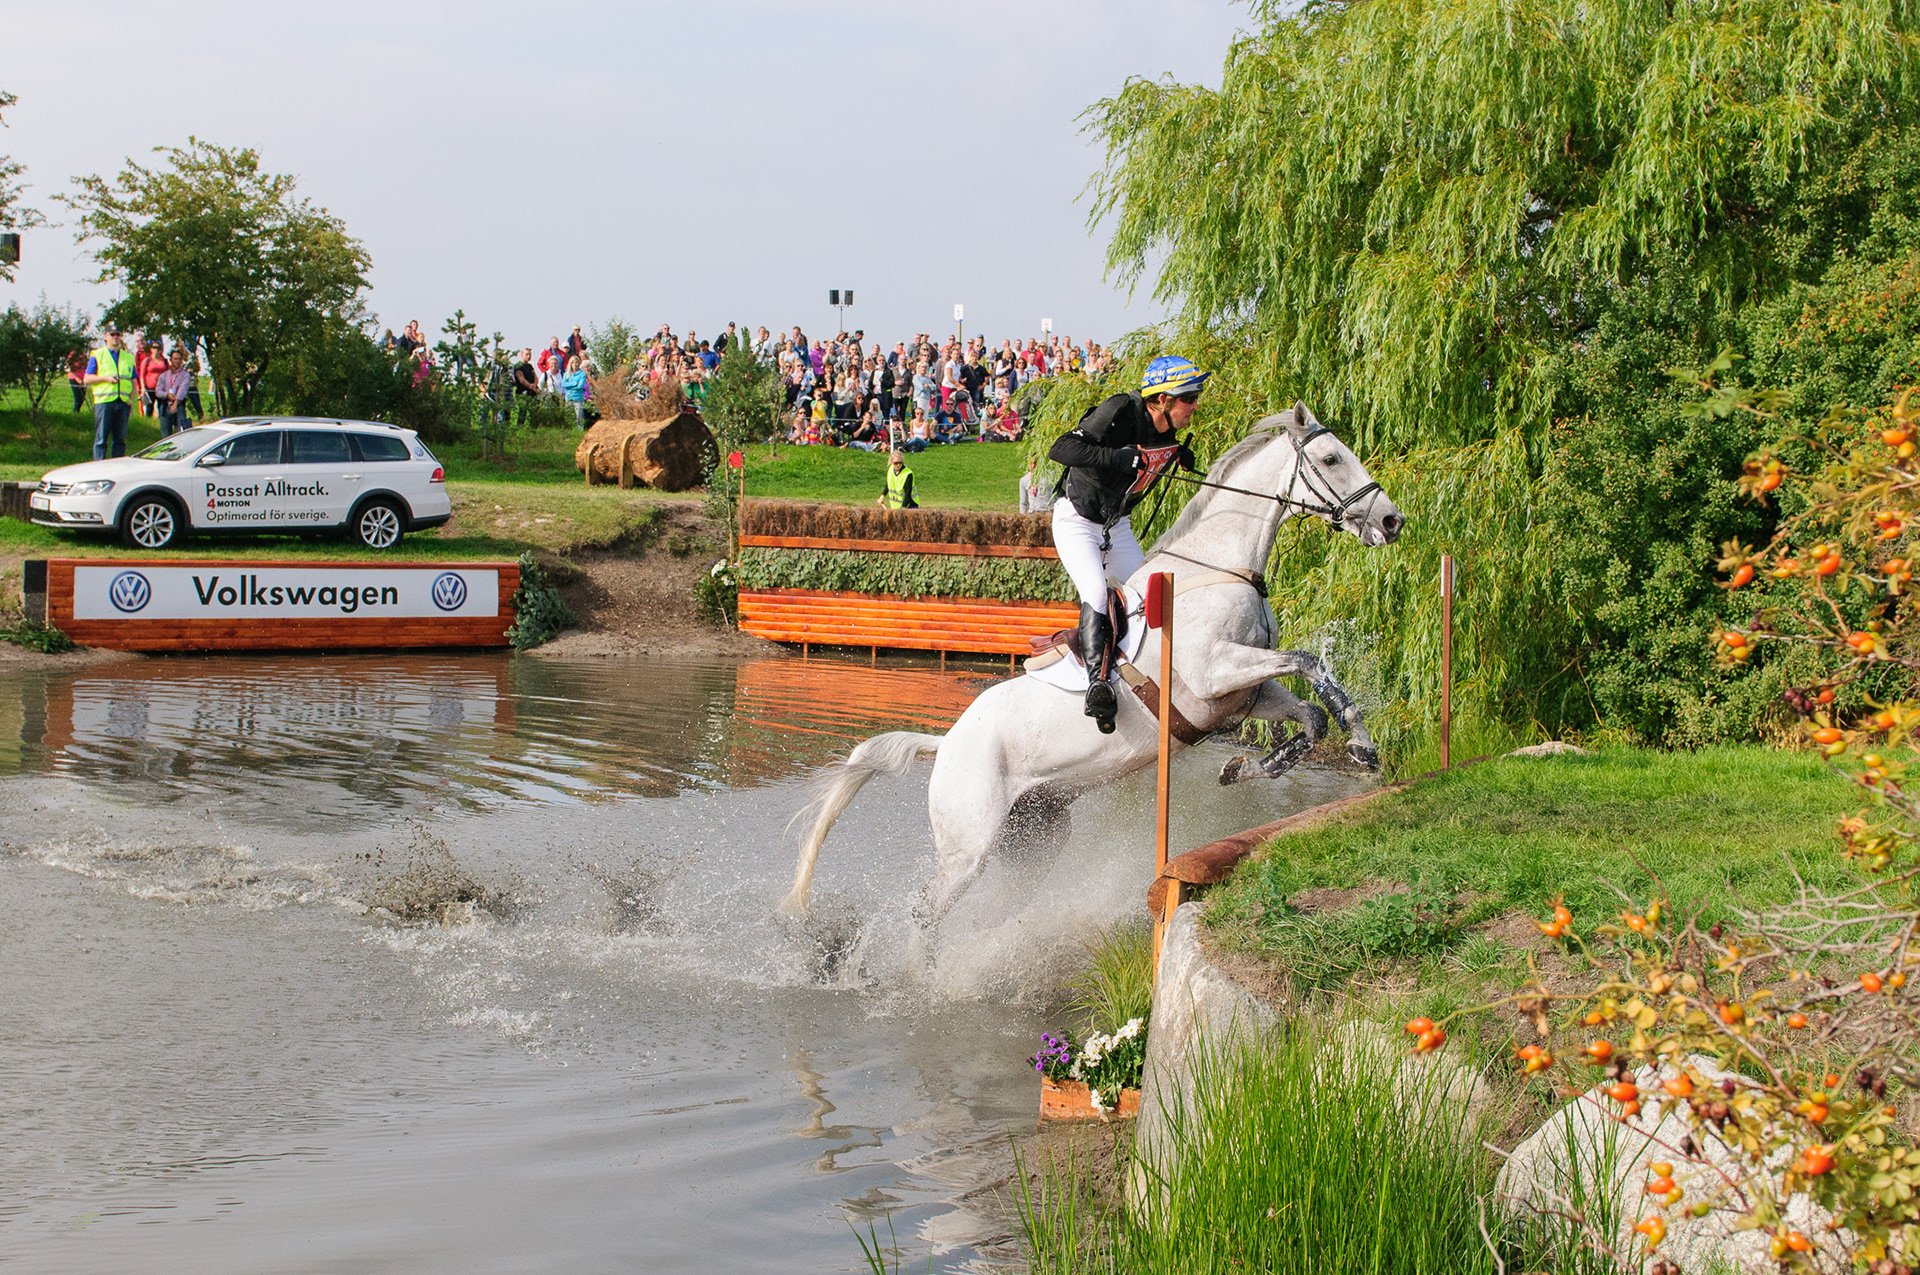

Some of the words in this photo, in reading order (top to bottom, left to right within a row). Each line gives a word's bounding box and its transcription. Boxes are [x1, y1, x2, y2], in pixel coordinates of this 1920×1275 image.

[206, 482, 259, 497] Passat
[264, 480, 329, 496] Alltrack.
[206, 510, 267, 523] Optimerad
[270, 509, 285, 520] för
[288, 509, 329, 521] sverige.
[192, 574, 398, 613] Volkswagen
